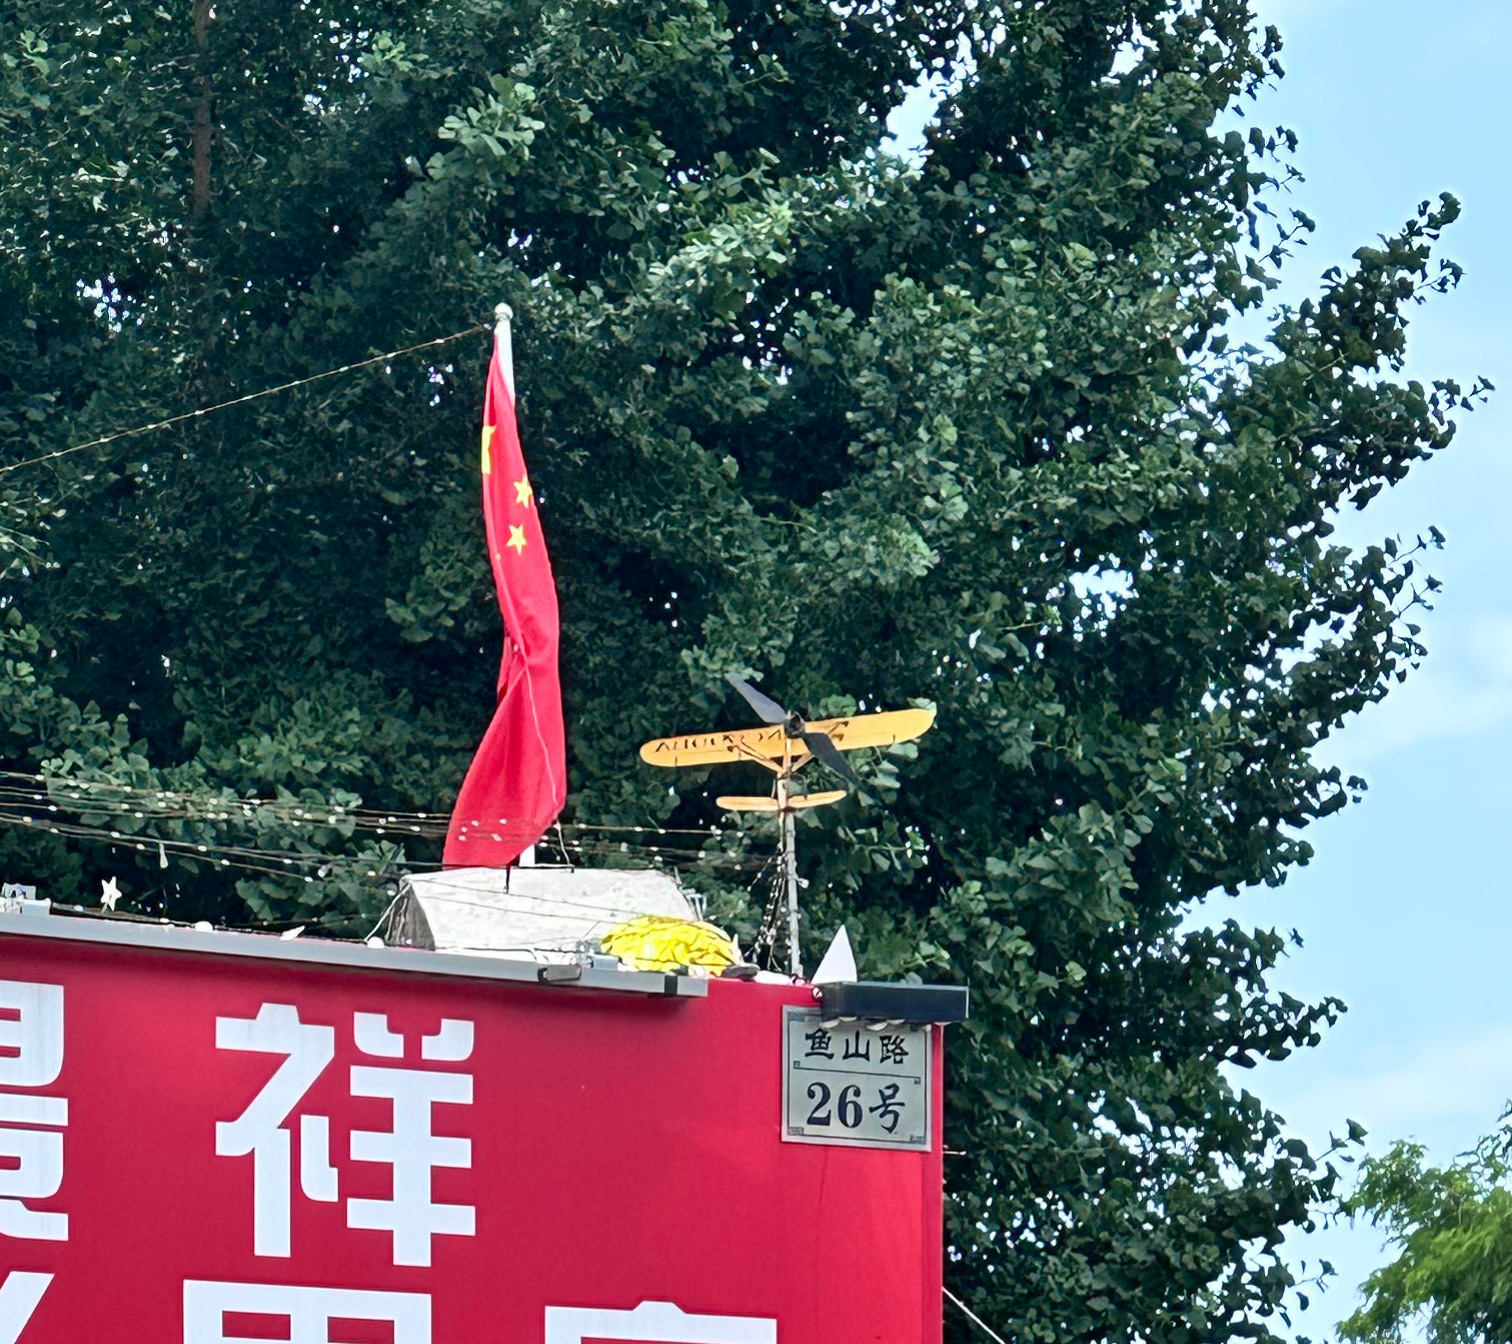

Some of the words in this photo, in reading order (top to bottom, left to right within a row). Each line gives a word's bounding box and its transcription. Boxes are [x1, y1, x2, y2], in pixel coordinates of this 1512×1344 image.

[805, 1028, 909, 1065] 鱼山路
[807, 1081, 906, 1134] 26号
